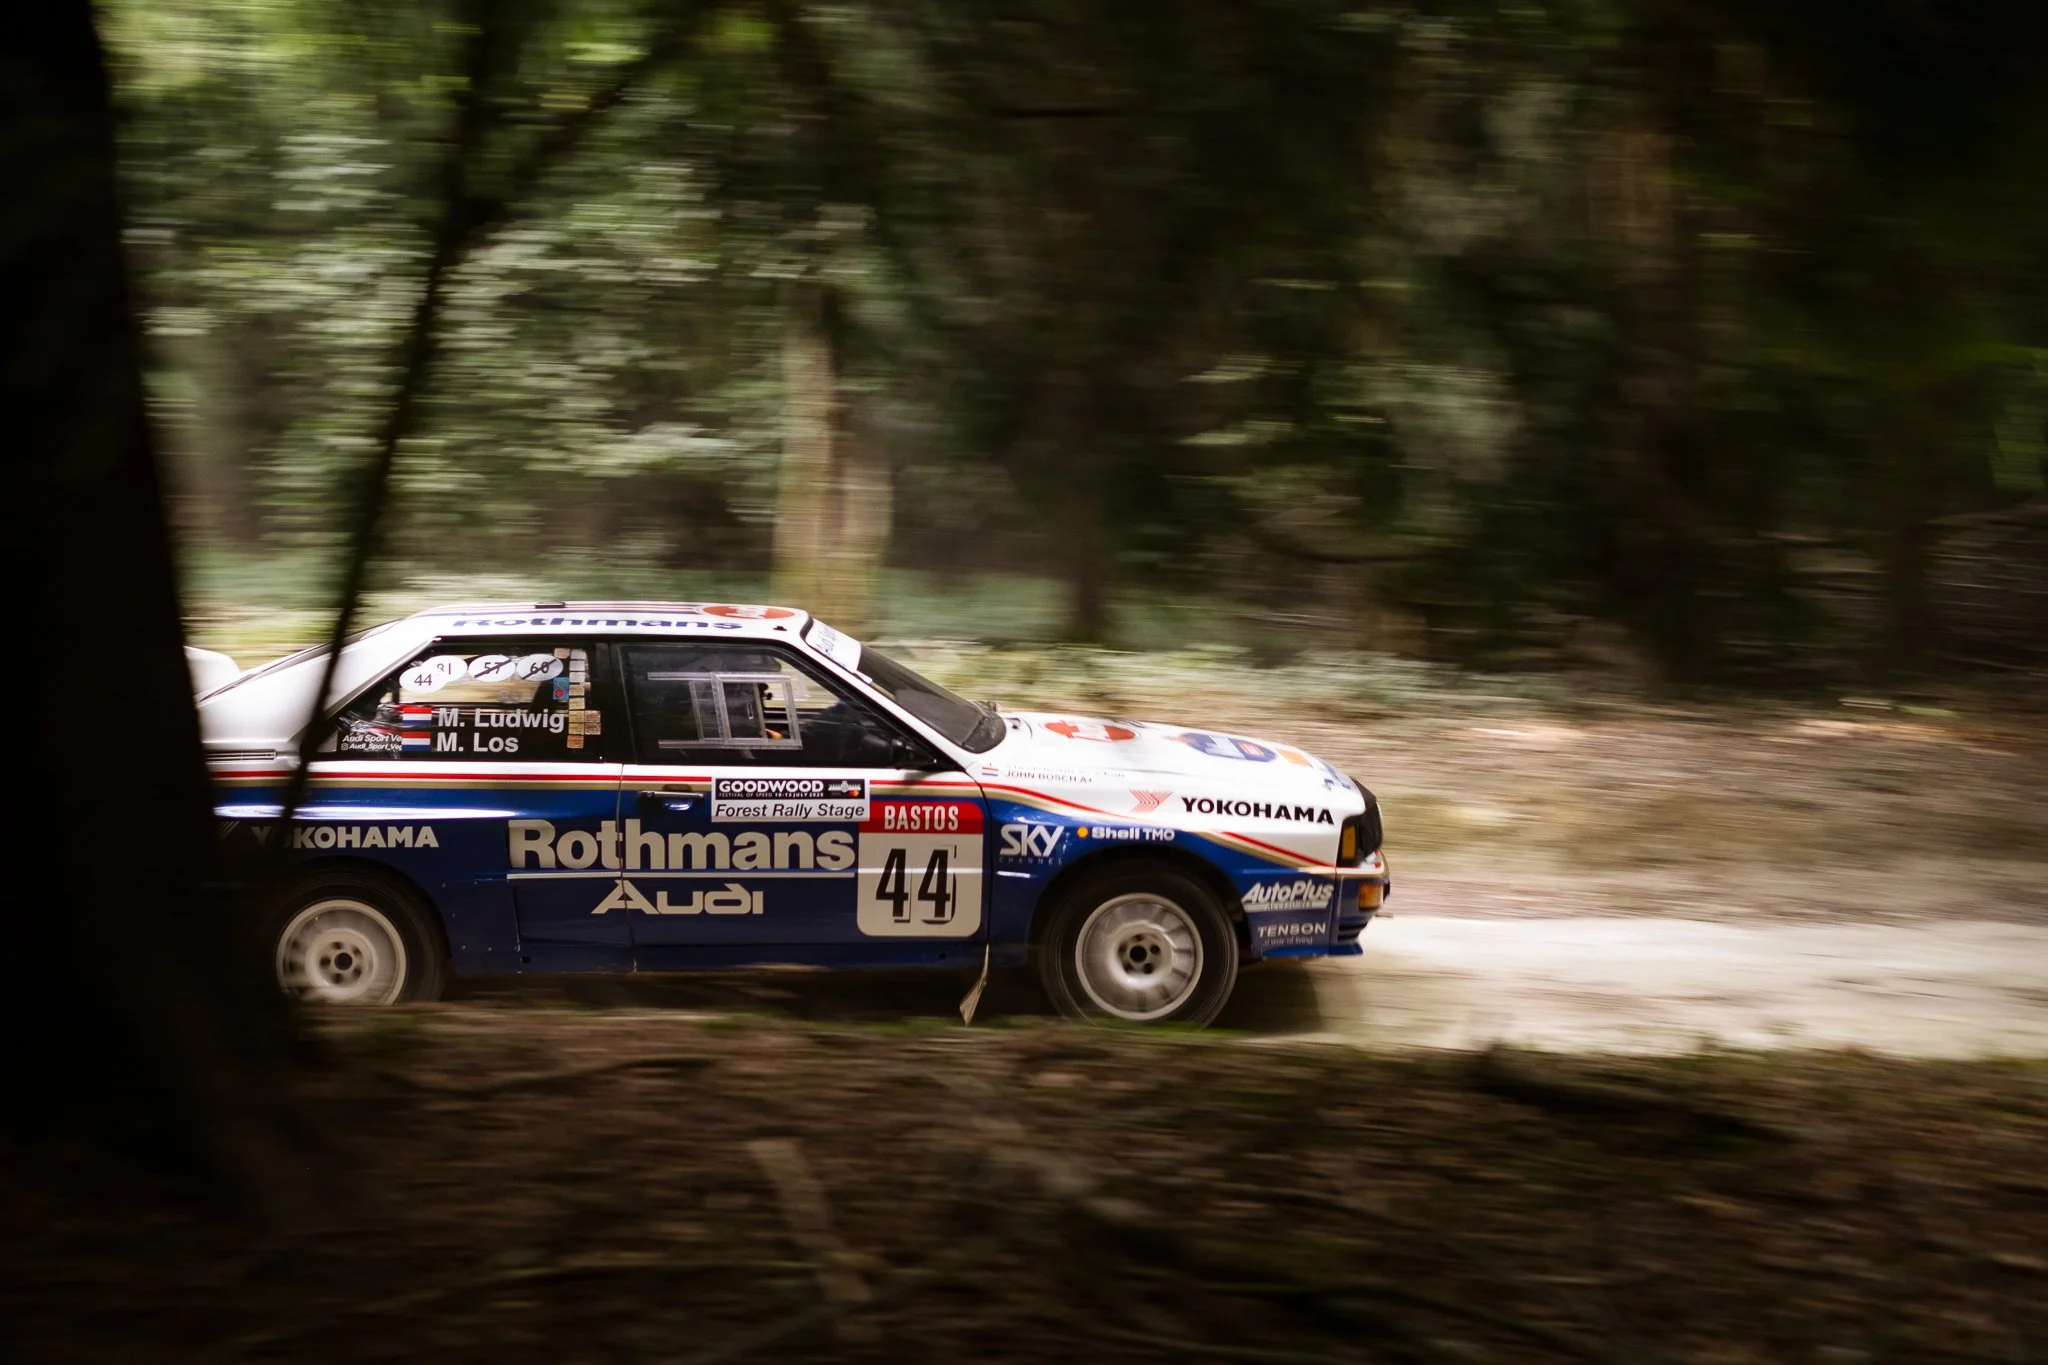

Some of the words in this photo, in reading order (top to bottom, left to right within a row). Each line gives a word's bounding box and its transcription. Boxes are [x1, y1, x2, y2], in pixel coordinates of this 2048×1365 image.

[453, 617, 743, 629] Rothmans
[414, 673, 433, 687] 44
[438, 708, 465, 728] M.
[474, 708, 564, 733] Ludwig
[342, 734, 363, 742] Audi
[364, 734, 389, 743] Sport
[436, 732, 464, 752] M.
[473, 732, 519, 752] Los
[719, 780, 824, 793] GOODWOOD
[715, 803, 767, 817] Forest
[772, 803, 812, 820] Rally
[817, 803, 865, 819] Stage
[884, 805, 959, 831] BASTOS
[1181, 797, 1335, 825] YOKOHAMA
[508, 819, 855, 871] Rothmans
[1000, 824, 1064, 857] SKY
[1091, 827, 1140, 841] Shell
[1143, 828, 1176, 842] TMO
[875, 848, 951, 919] 44
[1240, 879, 1334, 905] AutoPlus
[591, 879, 764, 915] Audi
